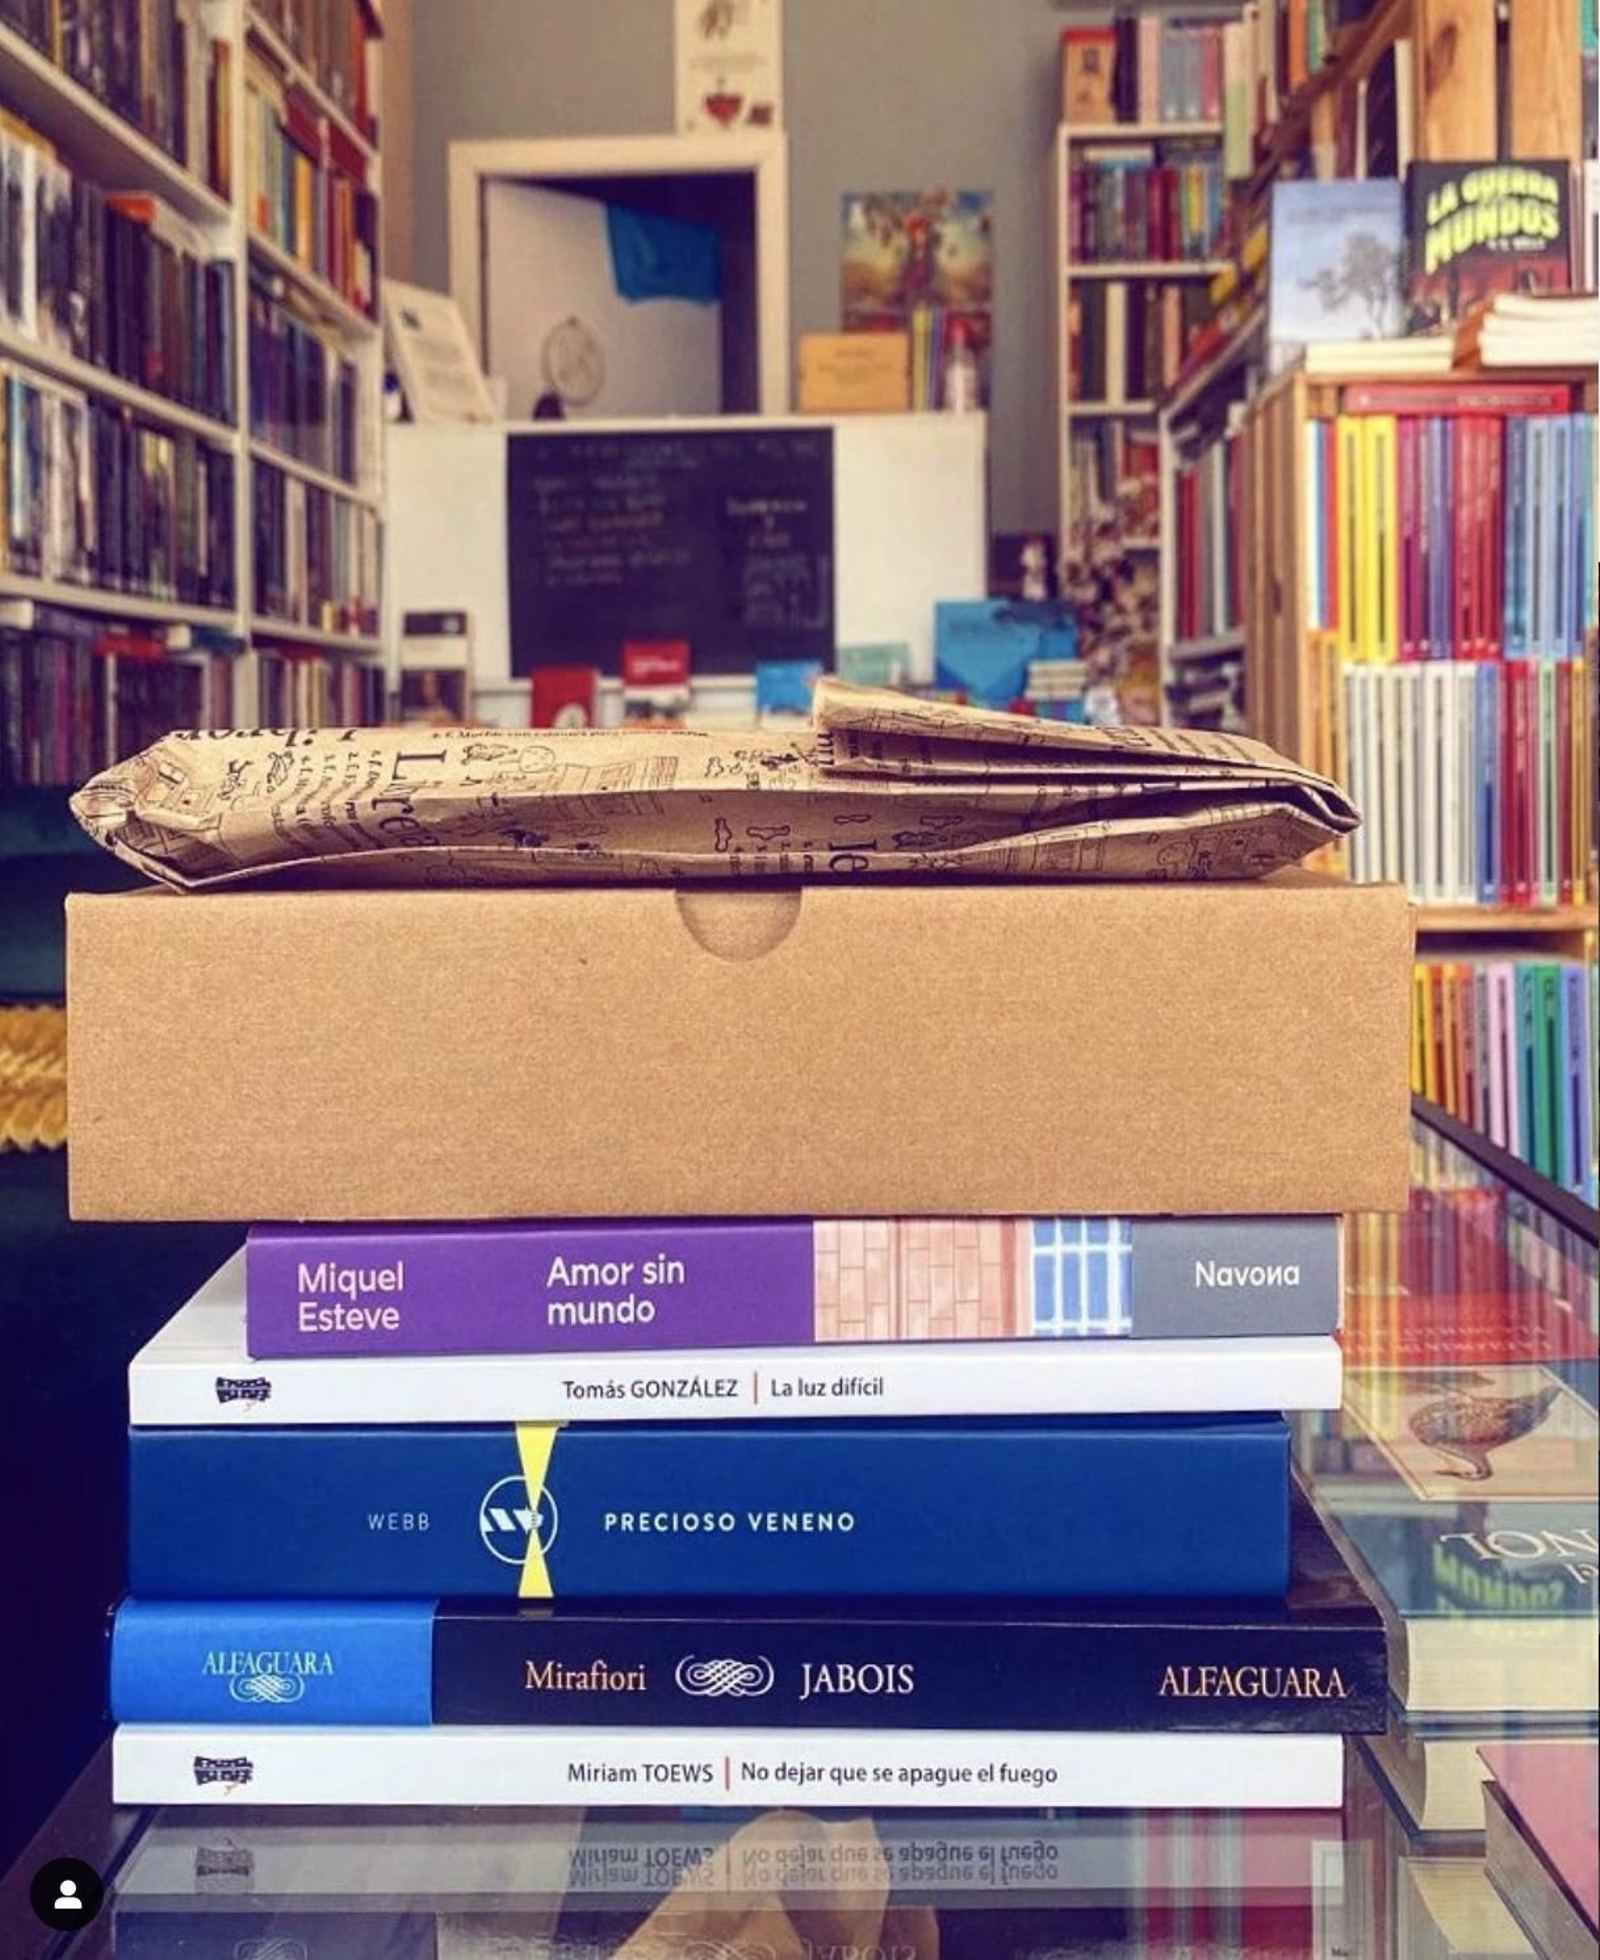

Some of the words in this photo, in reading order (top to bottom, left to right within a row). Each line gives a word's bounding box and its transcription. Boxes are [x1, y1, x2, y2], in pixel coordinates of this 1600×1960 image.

[1427, 180, 1459, 226] LA
[1425, 197, 1560, 276] MUNDOS
[298, 1261, 404, 1295] Miquel
[546, 1256, 634, 1288] Amor
[642, 1254, 685, 1285] sin
[298, 1300, 400, 1332] Esteve
[547, 1293, 656, 1325] mundo
[561, 1378, 626, 1400] Tomás
[630, 1375, 739, 1399] GONZÁLEZ
[770, 1379, 793, 1397] La
[798, 1377, 827, 1397] luz
[831, 1375, 884, 1397] difícil
[367, 1512, 431, 1531] WEBB
[604, 1512, 736, 1532] PRECIOSO
[747, 1512, 855, 1532] VENENO
[202, 1652, 334, 1677] ALFAGUARA
[525, 1659, 647, 1691] Mirafiori
[799, 1663, 914, 1699] JABOIS
[1159, 1665, 1346, 1699] ALFAGUARA
[567, 1762, 637, 1783] Miriam
[641, 1763, 714, 1783] TOEWS
[741, 1763, 770, 1782] No
[774, 1761, 825, 1787] dejar
[829, 1767, 869, 1787] que
[872, 1767, 894, 1782] se
[897, 1767, 973, 1788] apague
[977, 1762, 995, 1783] el
[999, 1761, 1058, 1789] fuego
